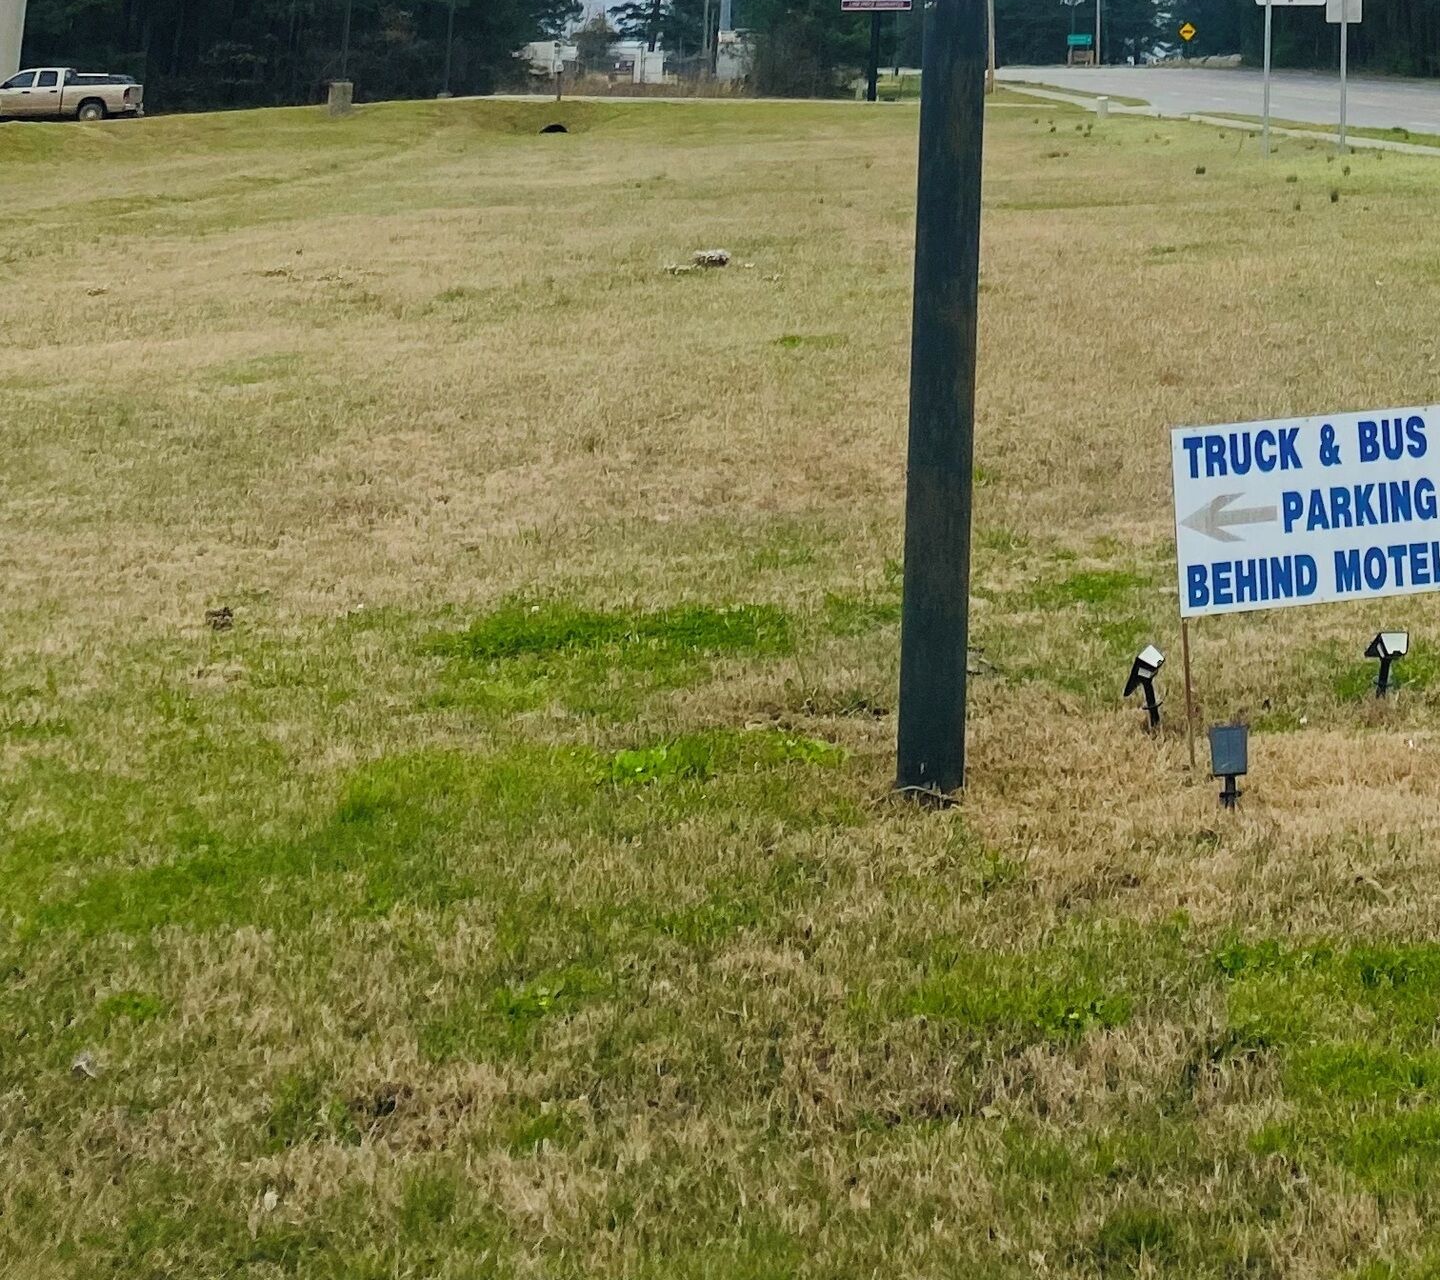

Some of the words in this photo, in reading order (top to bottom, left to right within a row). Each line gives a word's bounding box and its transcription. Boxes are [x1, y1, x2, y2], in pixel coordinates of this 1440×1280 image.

[1183, 427, 1303, 479] TRUCK
[1319, 423, 1342, 467] &
[1357, 415, 1428, 463] BUS
[1282, 477, 1438, 534] PARKING
[1186, 554, 1318, 608] BEHIND
